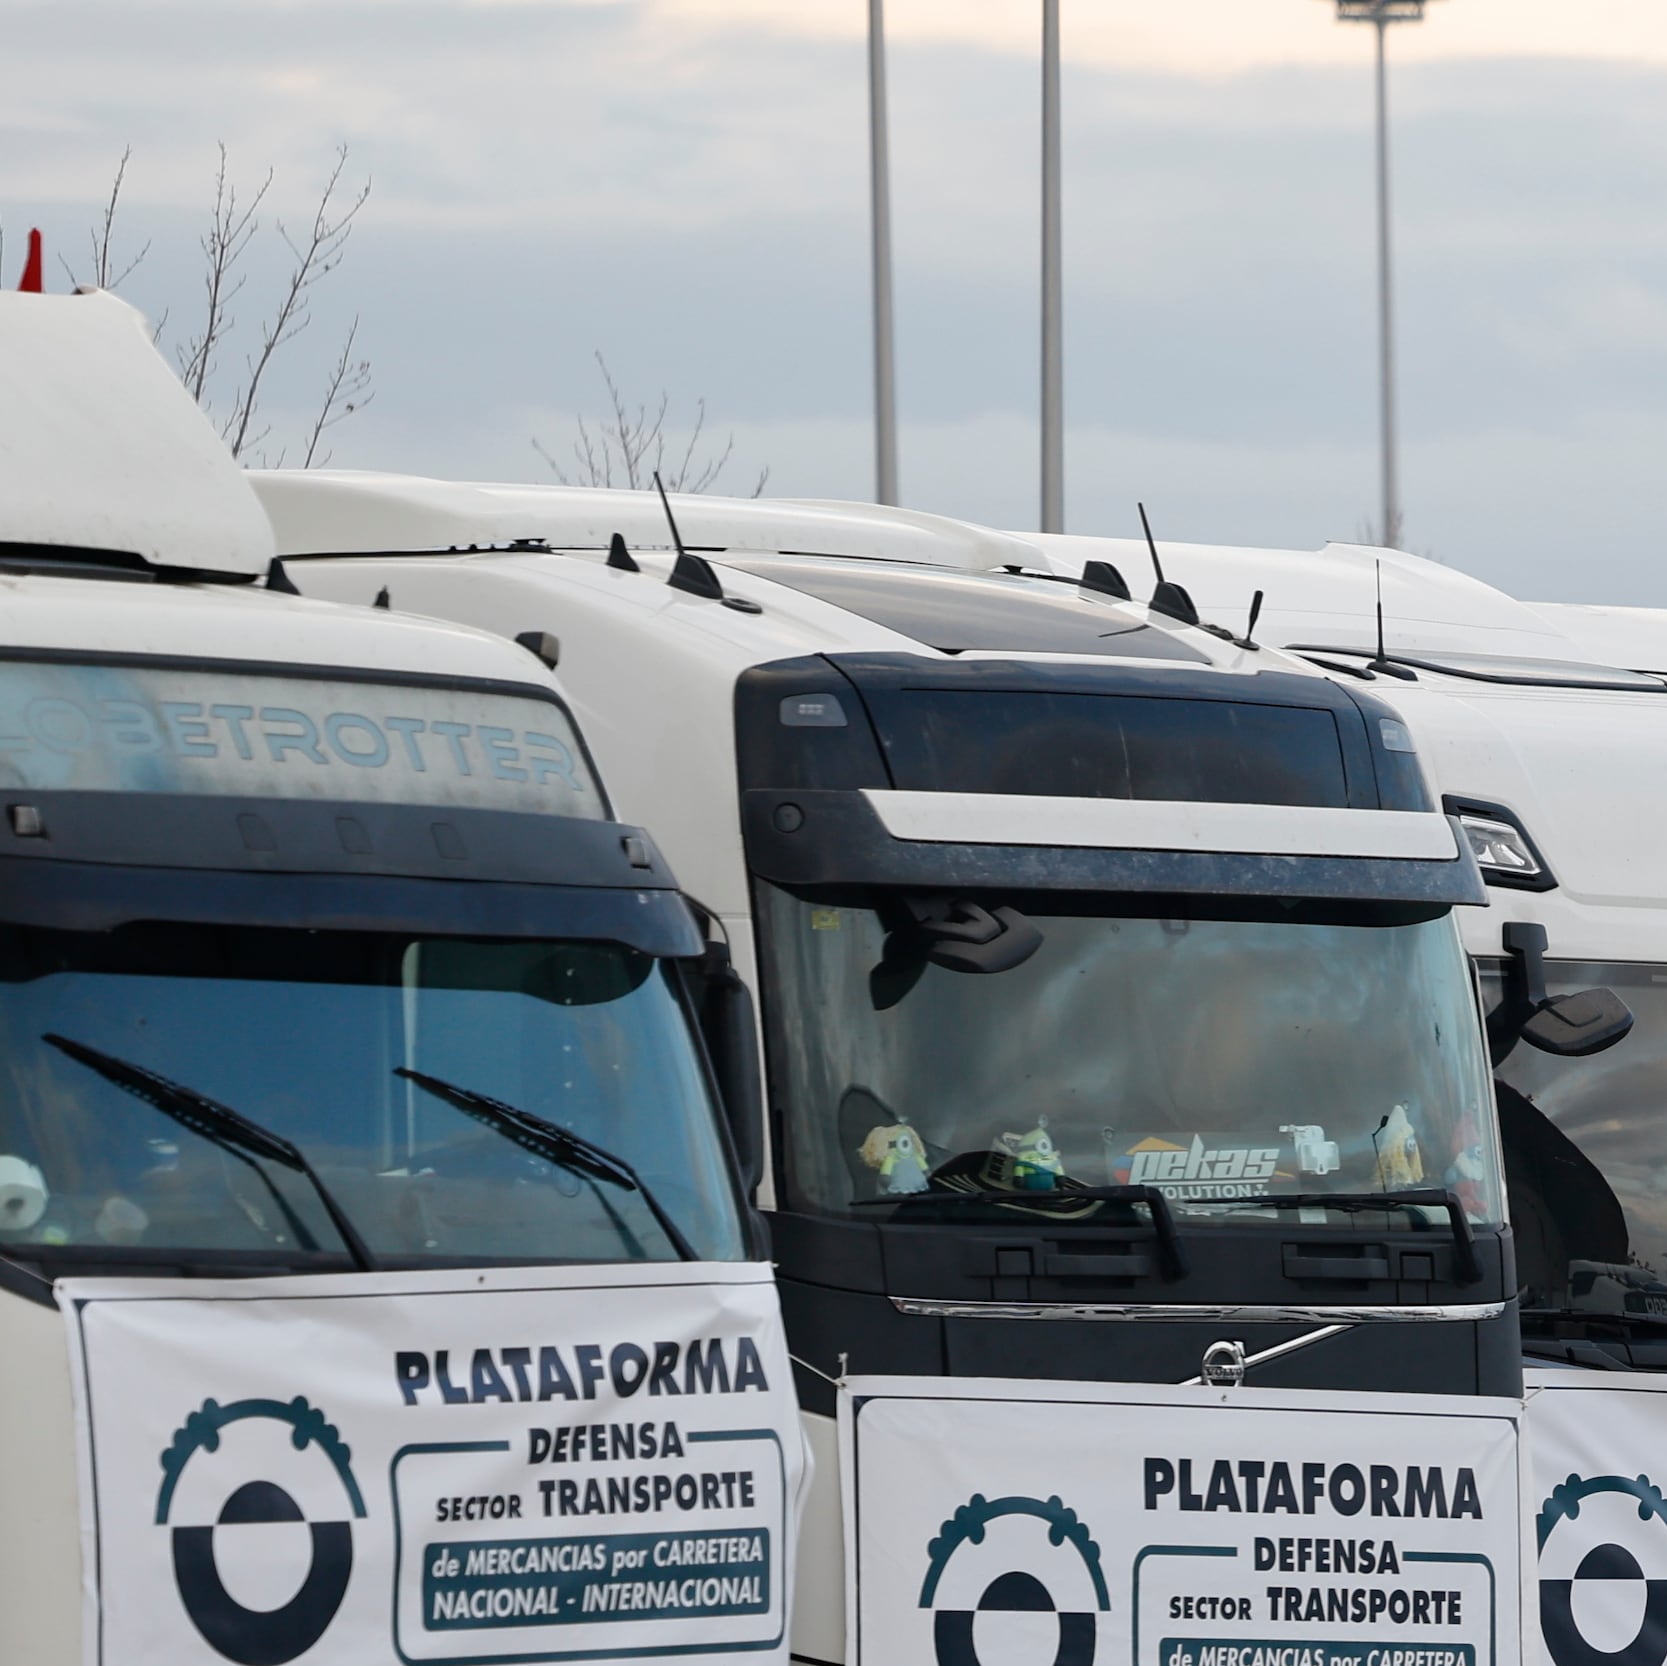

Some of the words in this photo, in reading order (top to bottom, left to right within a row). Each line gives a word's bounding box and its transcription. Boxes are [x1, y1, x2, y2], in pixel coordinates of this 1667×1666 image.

[0, 697, 584, 791] OBETROTTER
[1128, 1133, 1280, 1186] pekas
[1159, 1184, 1251, 1199] OLUTION
[394, 1337, 768, 1406] PLATAFORMA
[527, 1421, 684, 1466] DEFENSA
[435, 1494, 523, 1524] SECTOR
[538, 1471, 756, 1518] TRANSPORTE
[1143, 1457, 1482, 1520] PLATAFORMA
[432, 1550, 461, 1579] de
[464, 1544, 607, 1576] MERCANCIAS
[610, 1549, 647, 1574] por
[653, 1537, 763, 1568] CARRETERA
[1254, 1536, 1400, 1576] DEFENSA
[432, 1587, 559, 1620] NACIONAL
[581, 1577, 763, 1612] INTERNACIONAL
[1169, 1596, 1252, 1621] SECTOR
[1266, 1587, 1462, 1625] TRANSPORTE
